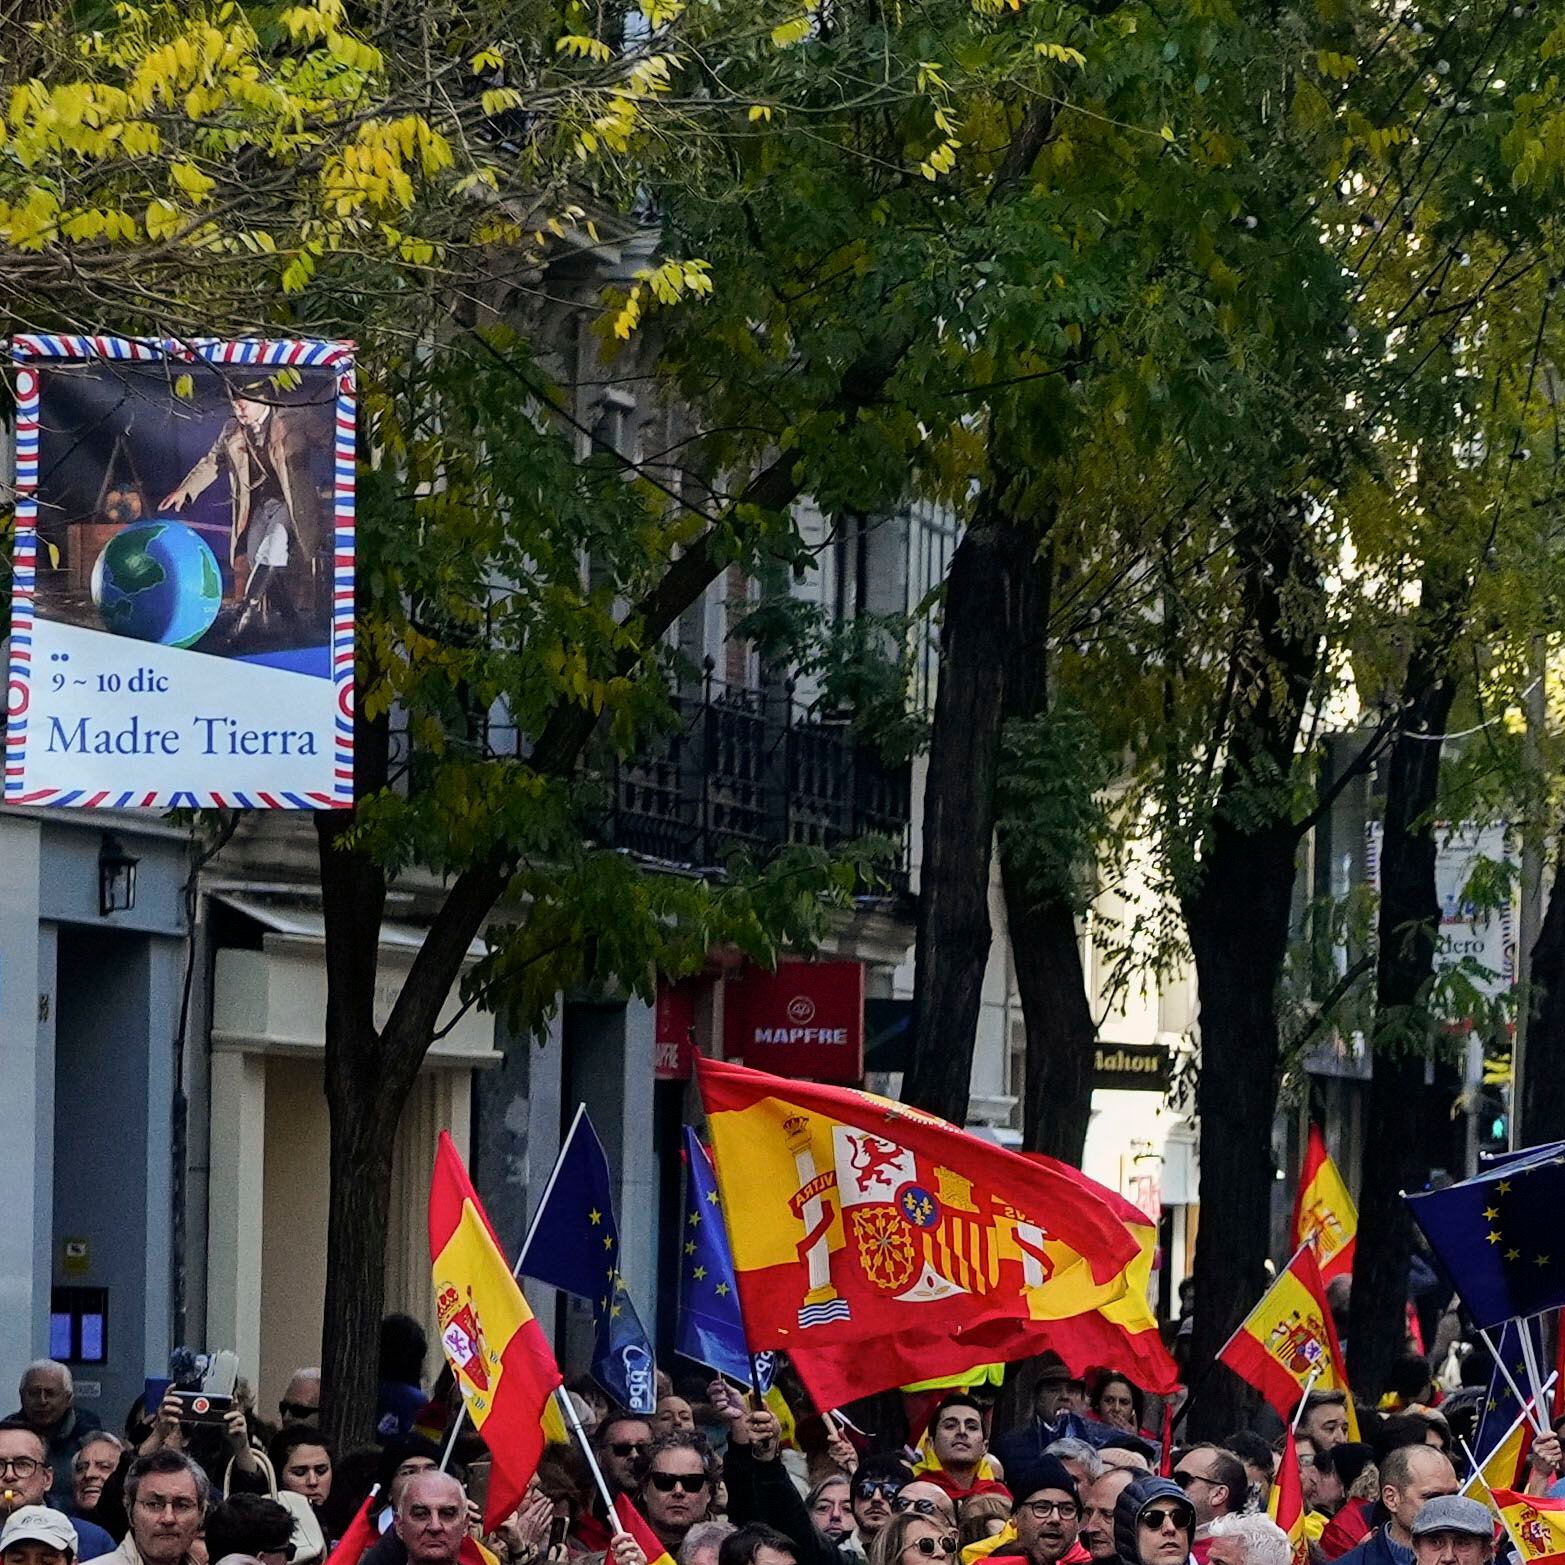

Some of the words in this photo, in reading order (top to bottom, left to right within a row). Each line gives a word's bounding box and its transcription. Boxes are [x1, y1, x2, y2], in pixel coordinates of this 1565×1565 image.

[52, 673, 65, 692] 9
[97, 673, 121, 692] 10
[128, 668, 169, 692] dic
[45, 715, 180, 755] Madre
[193, 716, 318, 755] Tierra
[1440, 934, 1485, 954] dero
[755, 1028, 847, 1044] MAPFRE
